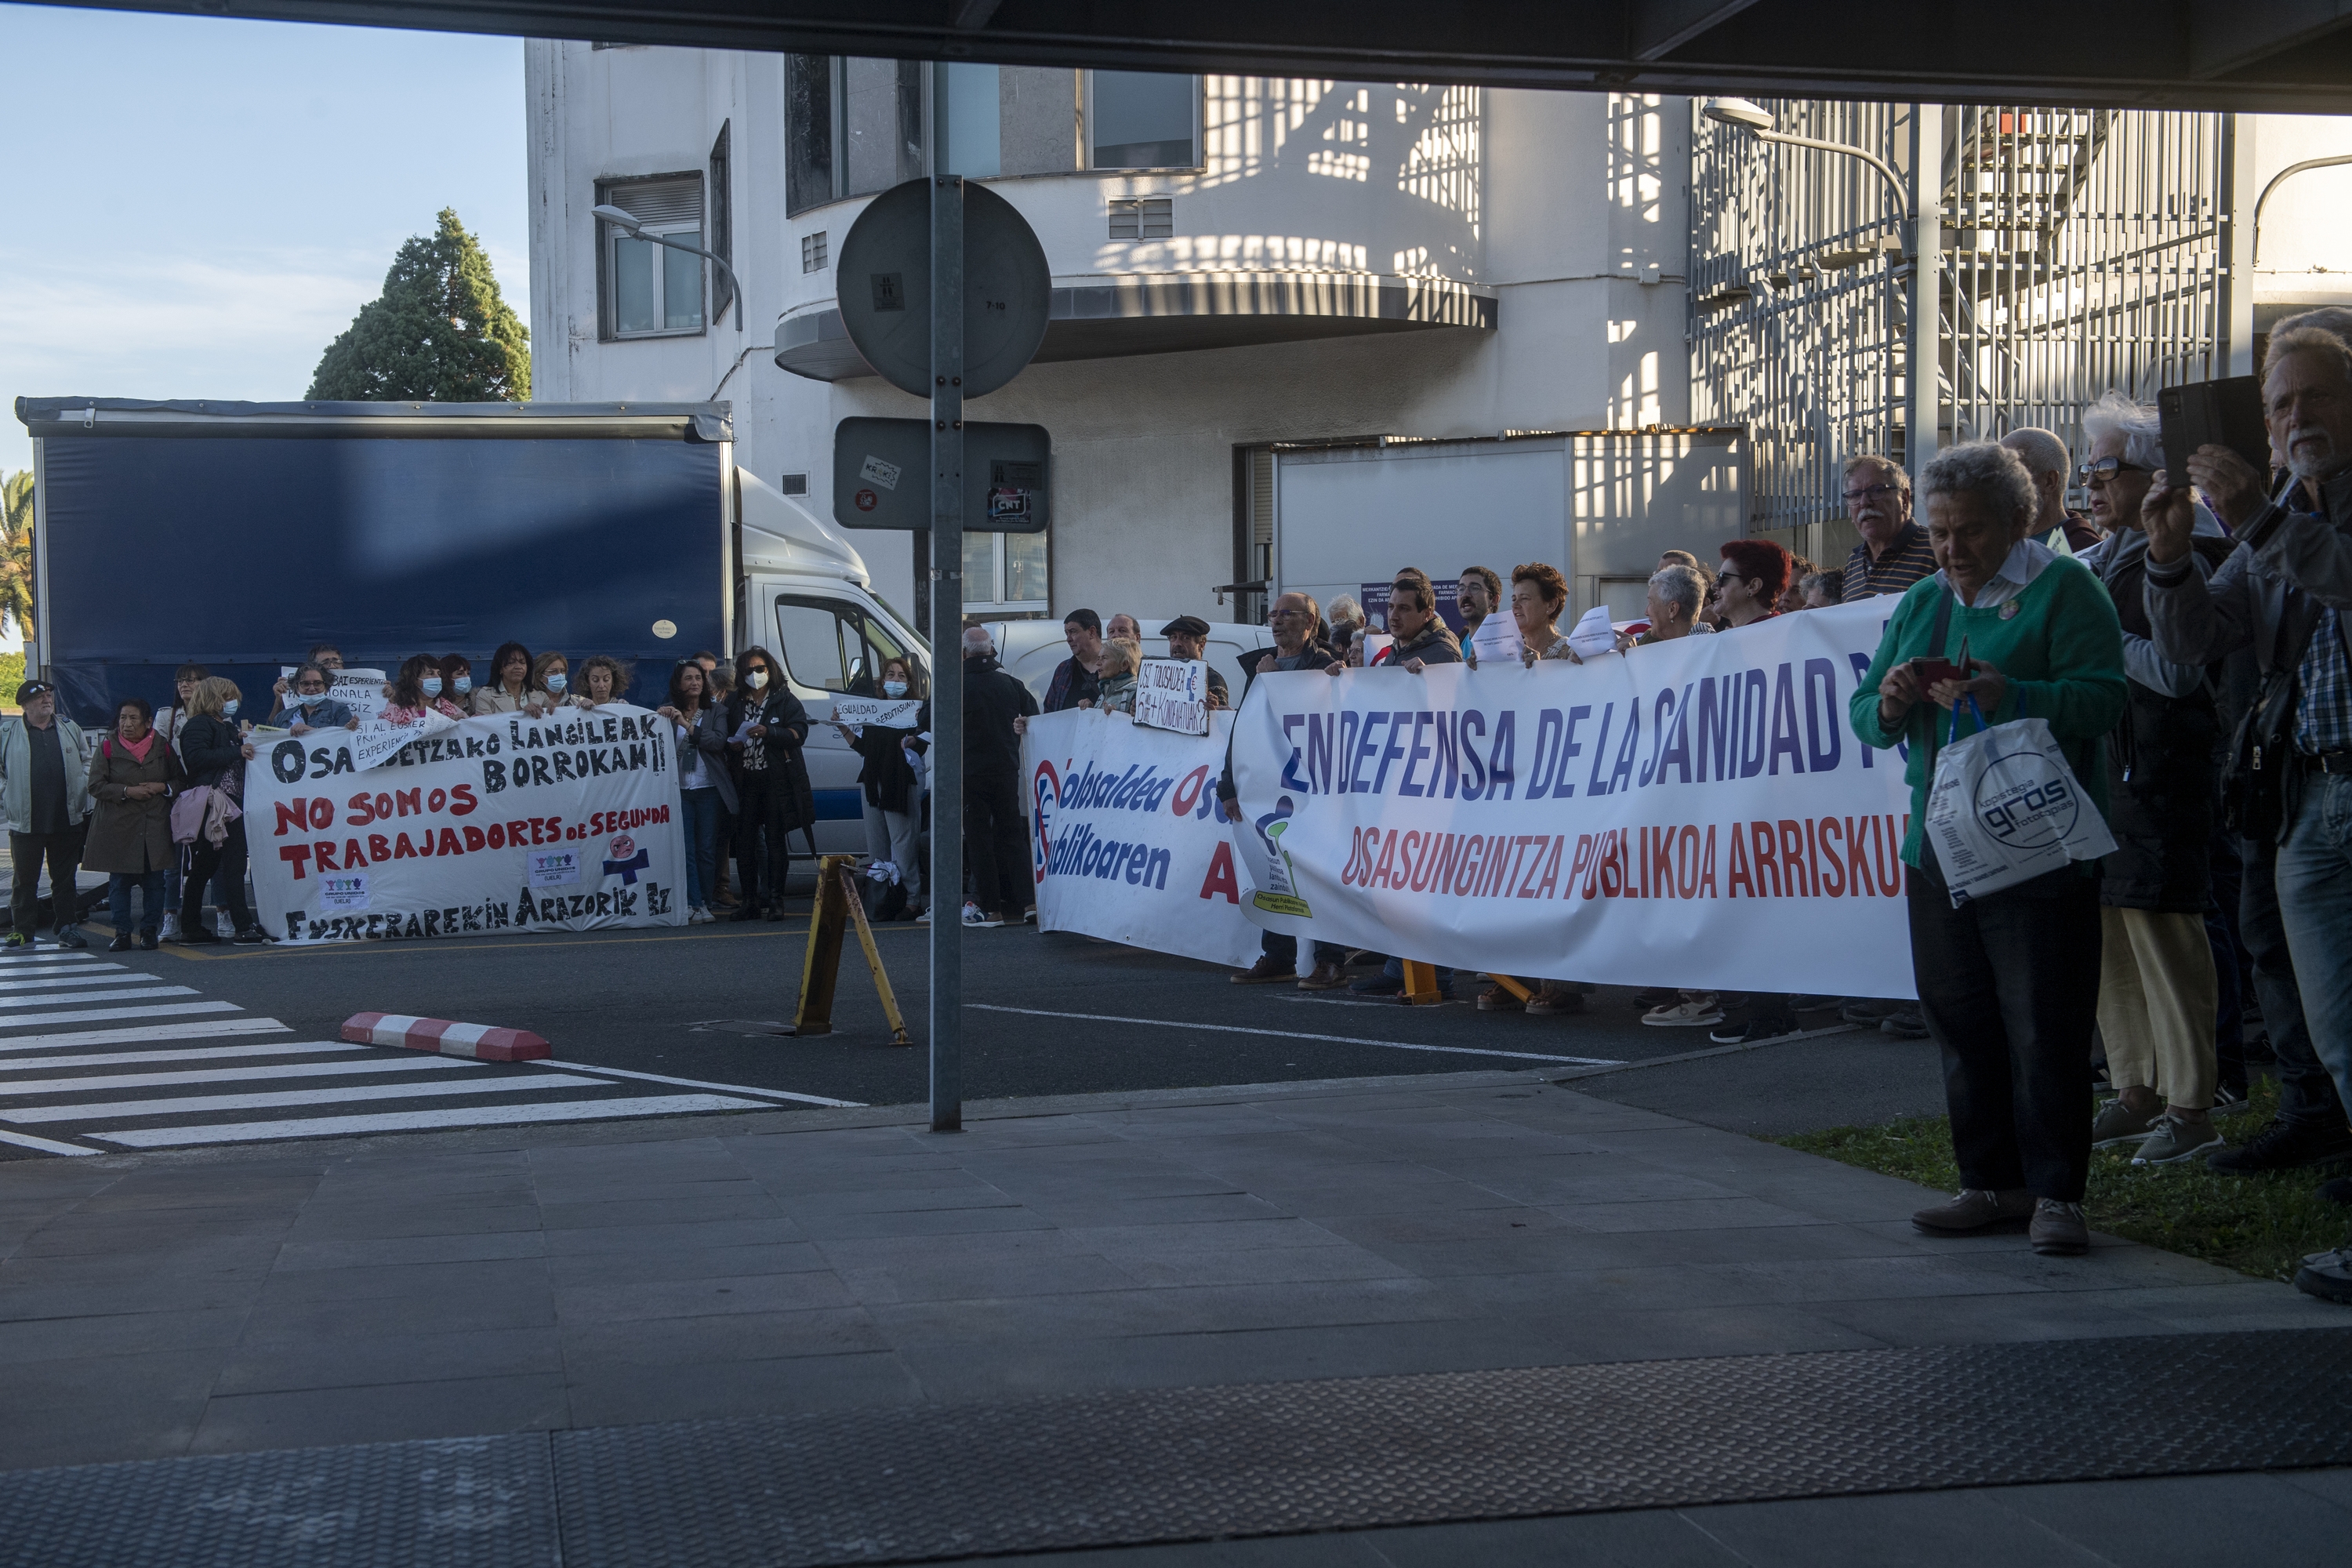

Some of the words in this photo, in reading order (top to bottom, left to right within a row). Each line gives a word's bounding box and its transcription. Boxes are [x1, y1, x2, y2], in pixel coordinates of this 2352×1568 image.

[998, 499, 1020, 510] CNT
[1153, 665, 1185, 692] TOLOSALDEA
[373, 723, 387, 732] AL
[838, 703, 878, 715] IGUALDAD
[1280, 712, 1334, 795] EN
[1338, 710, 1515, 801] DEFENSA
[1525, 705, 1592, 800] DE
[1587, 696, 1640, 797] LA
[1639, 657, 1842, 788] SANIDAD
[274, 797, 335, 836] NO
[347, 784, 478, 826] SOMOS
[1977, 779, 2035, 809] kopistegia
[1984, 779, 2067, 838] gros
[279, 816, 562, 880] TRABAJADORES
[566, 823, 587, 840] DE
[590, 804, 670, 837] SEGUNDA
[1341, 826, 1565, 899] OSASUNGINTZA
[1563, 824, 1718, 900] PUBLIKOA
[286, 898, 509, 940] EUSKERAREKIN
[514, 887, 637, 927] ARAZORIK
[646, 882, 672, 916] EZ
[1257, 894, 1279, 902] Osasun
